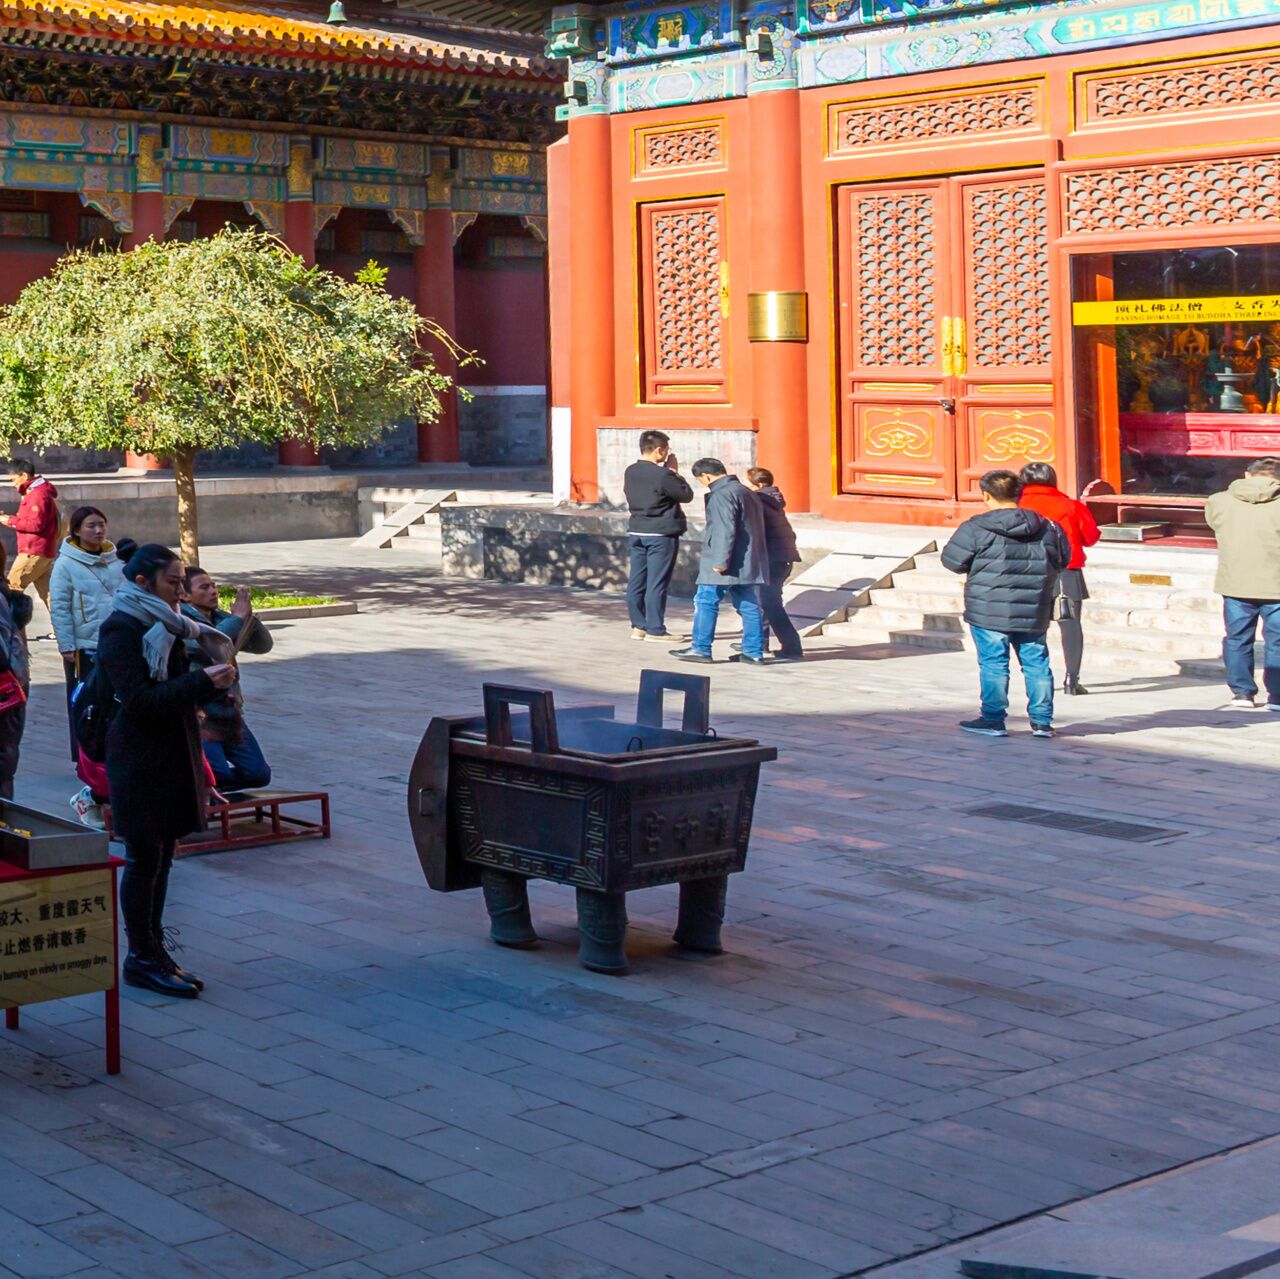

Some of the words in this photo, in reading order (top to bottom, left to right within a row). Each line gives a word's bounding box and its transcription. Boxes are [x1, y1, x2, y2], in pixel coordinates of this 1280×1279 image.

[3, 969, 29, 981] burning
[29, 967, 38, 977] on
[38, 964, 58, 977] windy
[66, 959, 92, 971] smoggy
[92, 954, 108, 966] days
